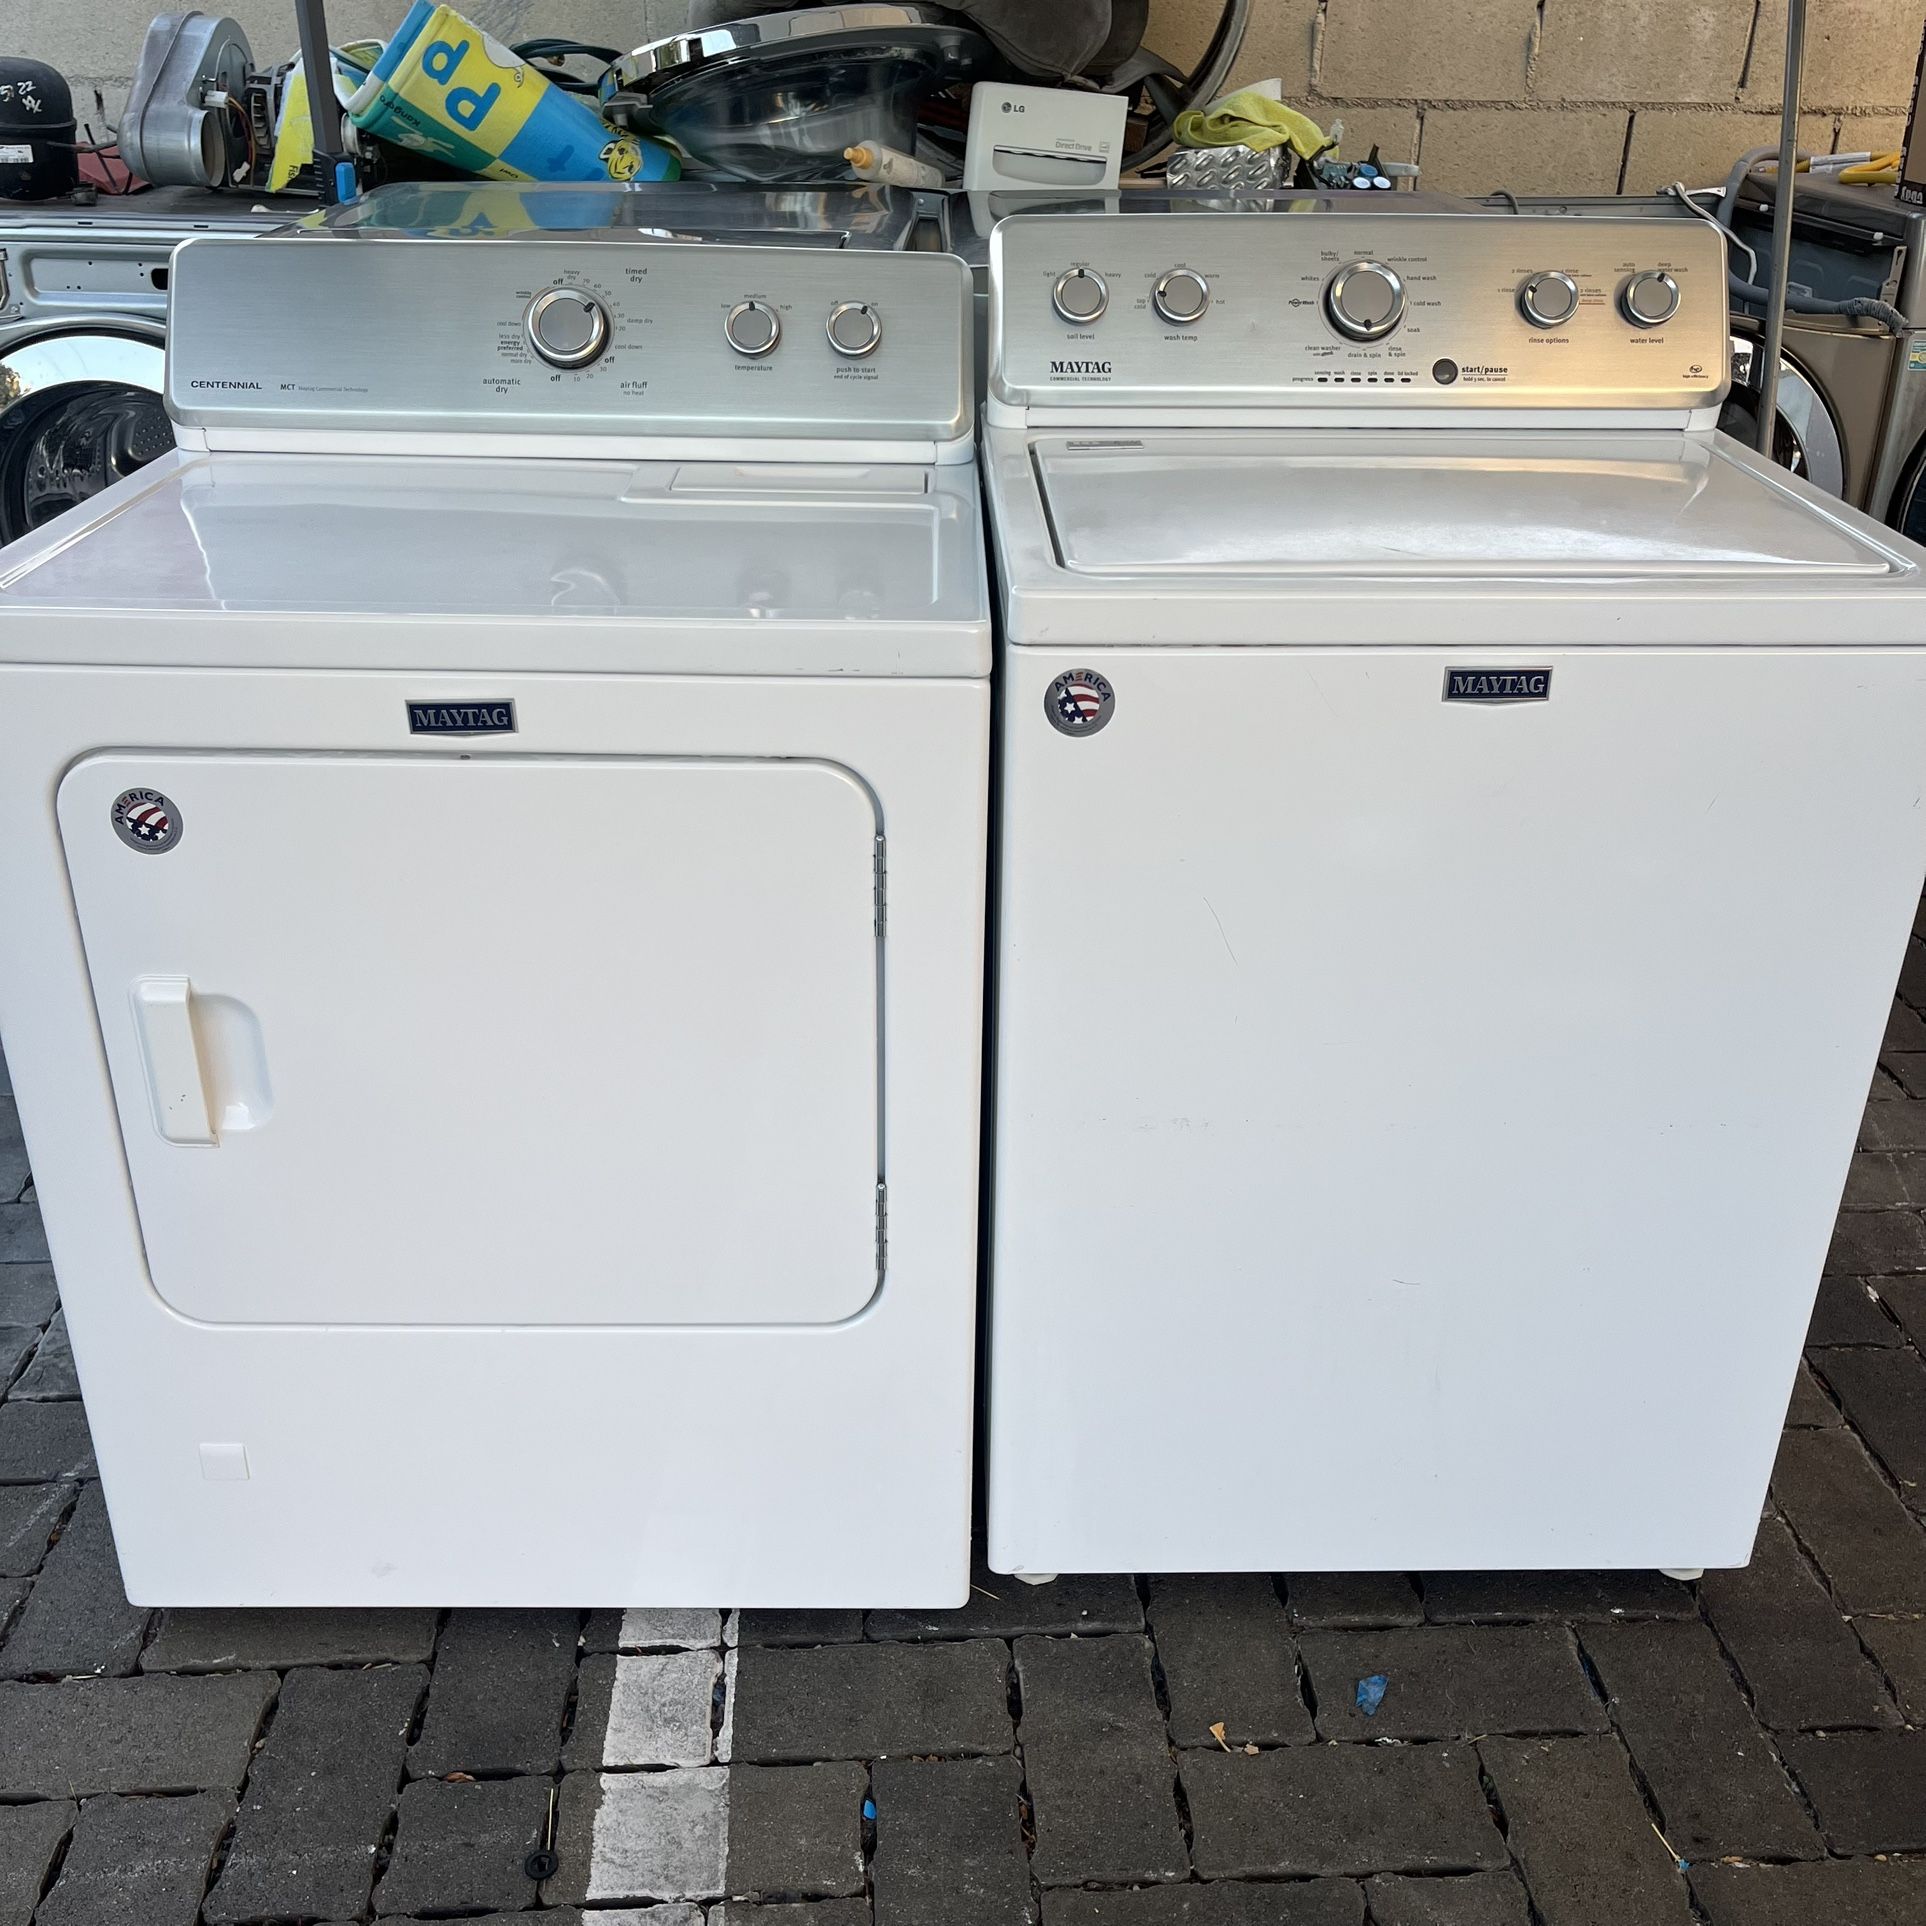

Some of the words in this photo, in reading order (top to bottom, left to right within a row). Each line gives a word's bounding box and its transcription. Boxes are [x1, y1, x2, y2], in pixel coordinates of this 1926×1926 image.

[1013, 104, 1025, 113] LG
[1055, 141, 1074, 150] Direct
[1075, 142, 1093, 151] Drive
[1320, 250, 1339, 258] bulky/
[625, 267, 648, 275] timed
[1042, 271, 1056, 279] light
[1105, 271, 1121, 279] heavy
[629, 275, 643, 283] dry
[1181, 335, 1198, 343] temp
[604, 356, 615, 364] off
[734, 364, 773, 372] temperature
[1050, 361, 1112, 374] MAYTAG
[1461, 365, 1508, 375] start/pause
[190, 380, 263, 390] CENTENNIAL
[482, 377, 521, 385] automatic
[620, 381, 630, 389] air
[631, 381, 648, 389] fluff
[280, 383, 296, 391] MCT
[495, 385, 509, 394] dry
[1054, 672, 1112, 702] AMERICA
[1452, 675, 1545, 694] MAYTAG
[413, 708, 509, 727] MAYTAG
[114, 790, 165, 826] AMERICA
